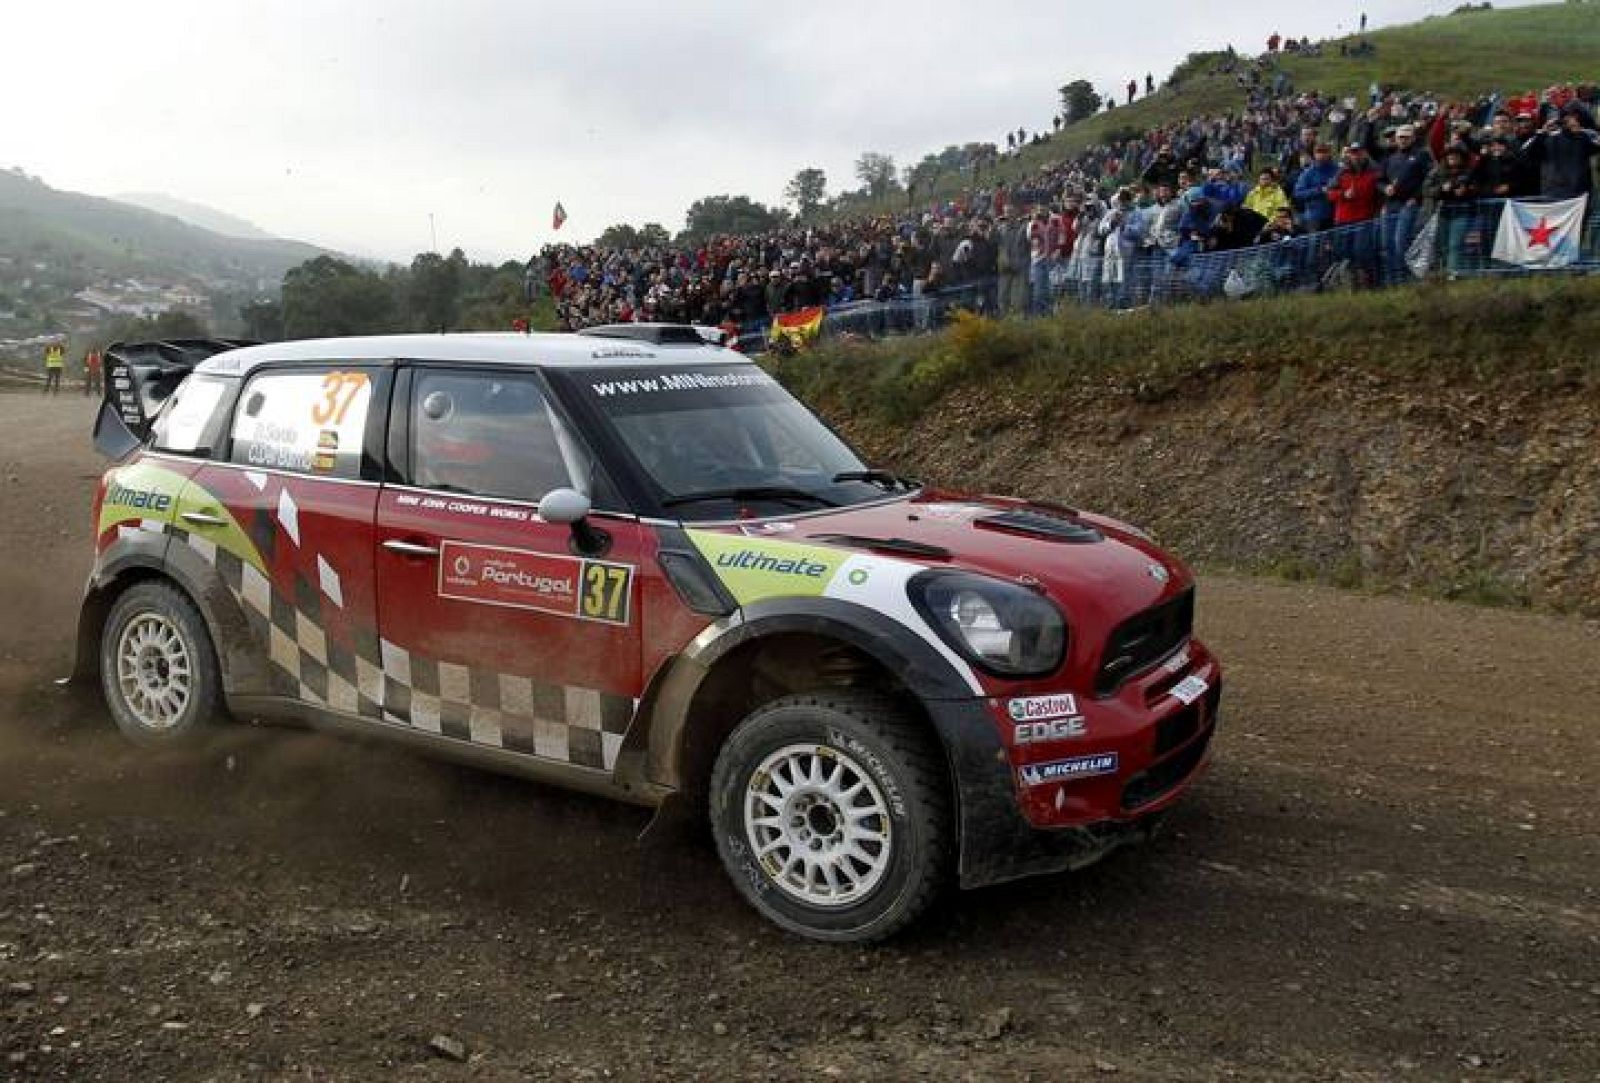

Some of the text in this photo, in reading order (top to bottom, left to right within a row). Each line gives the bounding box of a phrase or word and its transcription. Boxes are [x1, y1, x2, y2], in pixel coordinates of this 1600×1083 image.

[313, 371, 367, 425] 37
[420, 498, 446, 510] JOHN
[448, 502, 488, 515] COOPER
[491, 508, 528, 521] WORKS
[717, 549, 827, 578] ultimate
[483, 565, 627, 617] Portugal 37
[1025, 696, 1075, 718] Castrol
[1013, 715, 1088, 744] EDGE
[1043, 756, 1113, 779] MICHELIN
